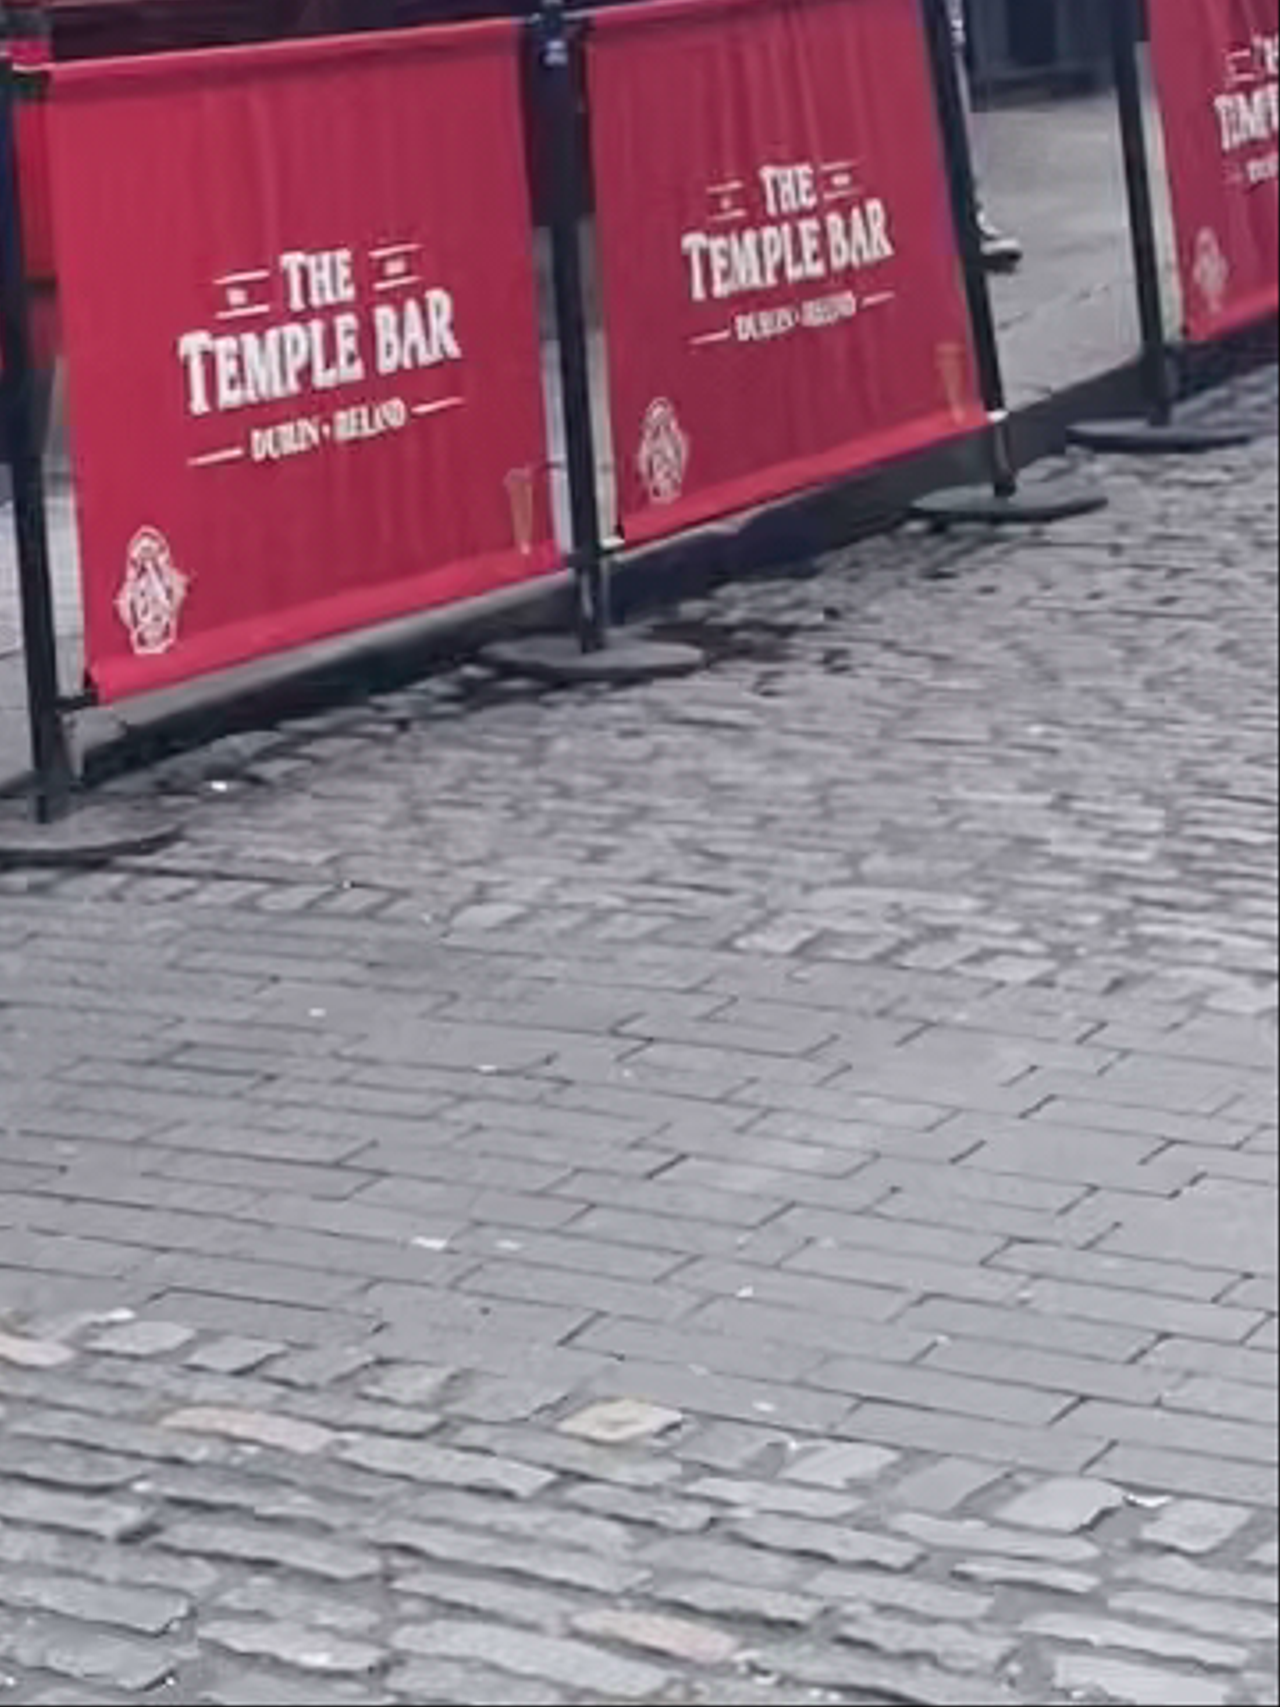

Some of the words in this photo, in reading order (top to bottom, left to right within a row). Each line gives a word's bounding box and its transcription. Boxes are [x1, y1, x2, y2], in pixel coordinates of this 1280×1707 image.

[759, 161, 818, 217] THE
[279, 247, 356, 312] THE
[681, 217, 825, 302] TEMPLE
[825, 197, 895, 270] BAR
[177, 312, 366, 416] TEMPLE
[373, 287, 463, 376] BAR
